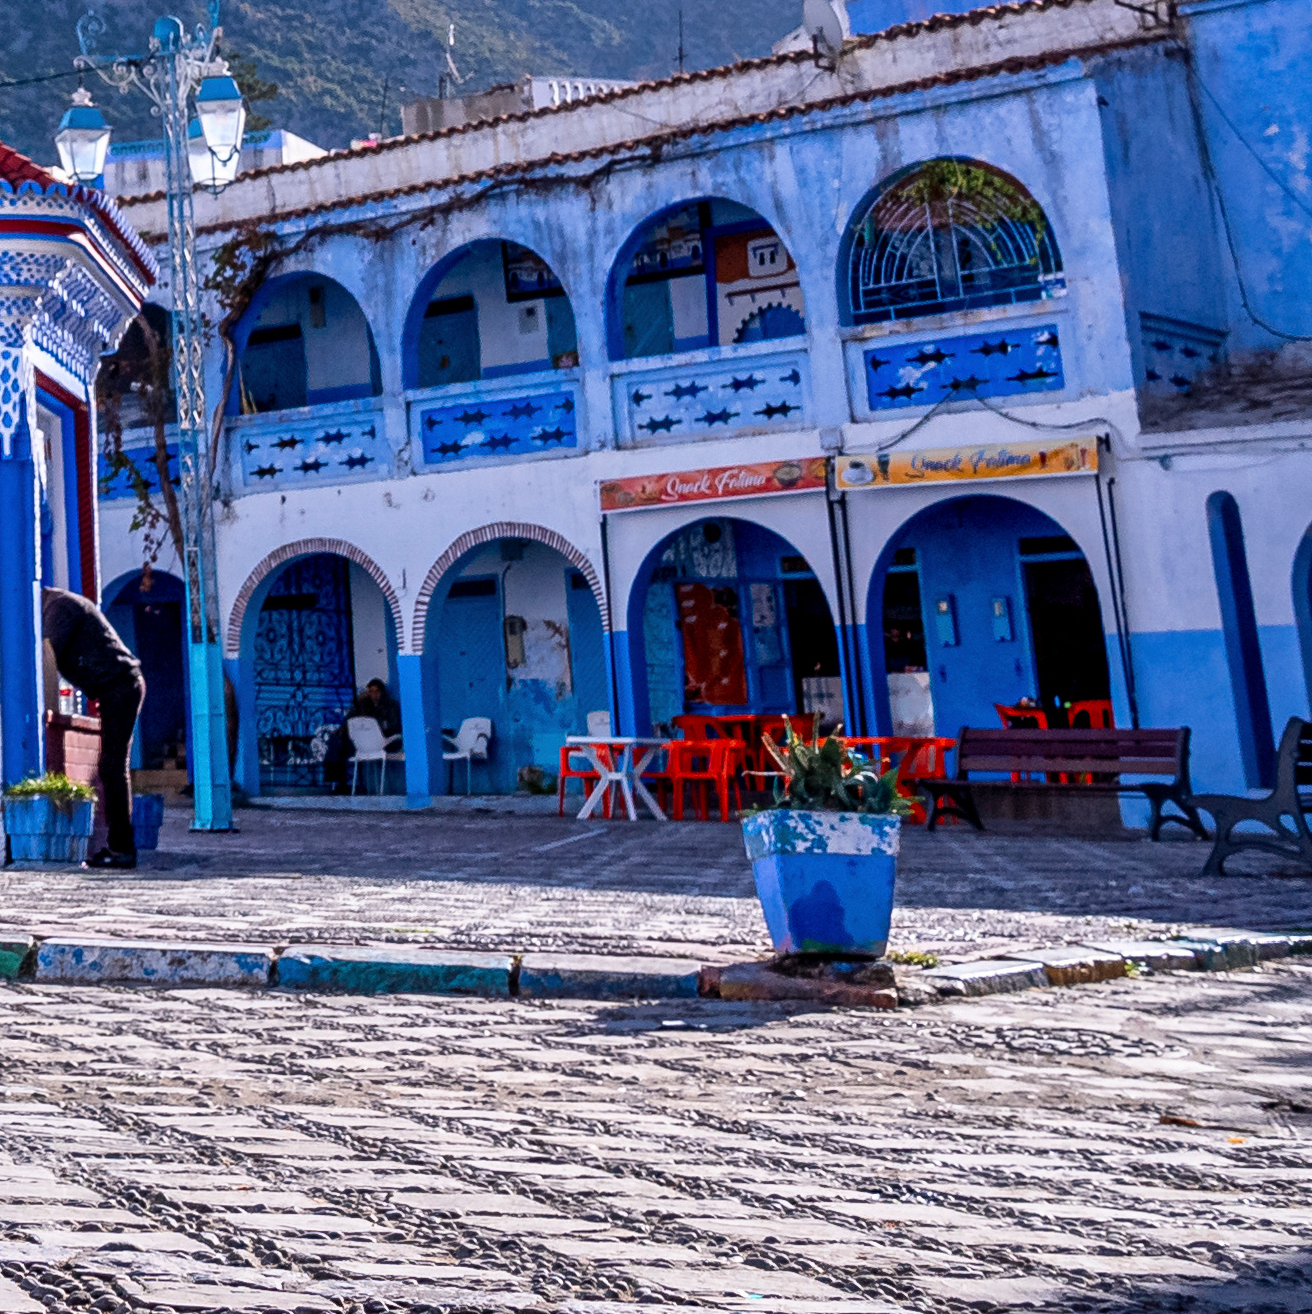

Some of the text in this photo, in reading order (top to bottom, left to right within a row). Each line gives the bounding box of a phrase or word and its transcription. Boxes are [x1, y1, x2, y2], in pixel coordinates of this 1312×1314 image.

[905, 453, 963, 478] Snack
[661, 469, 766, 501] Snack Fatima
